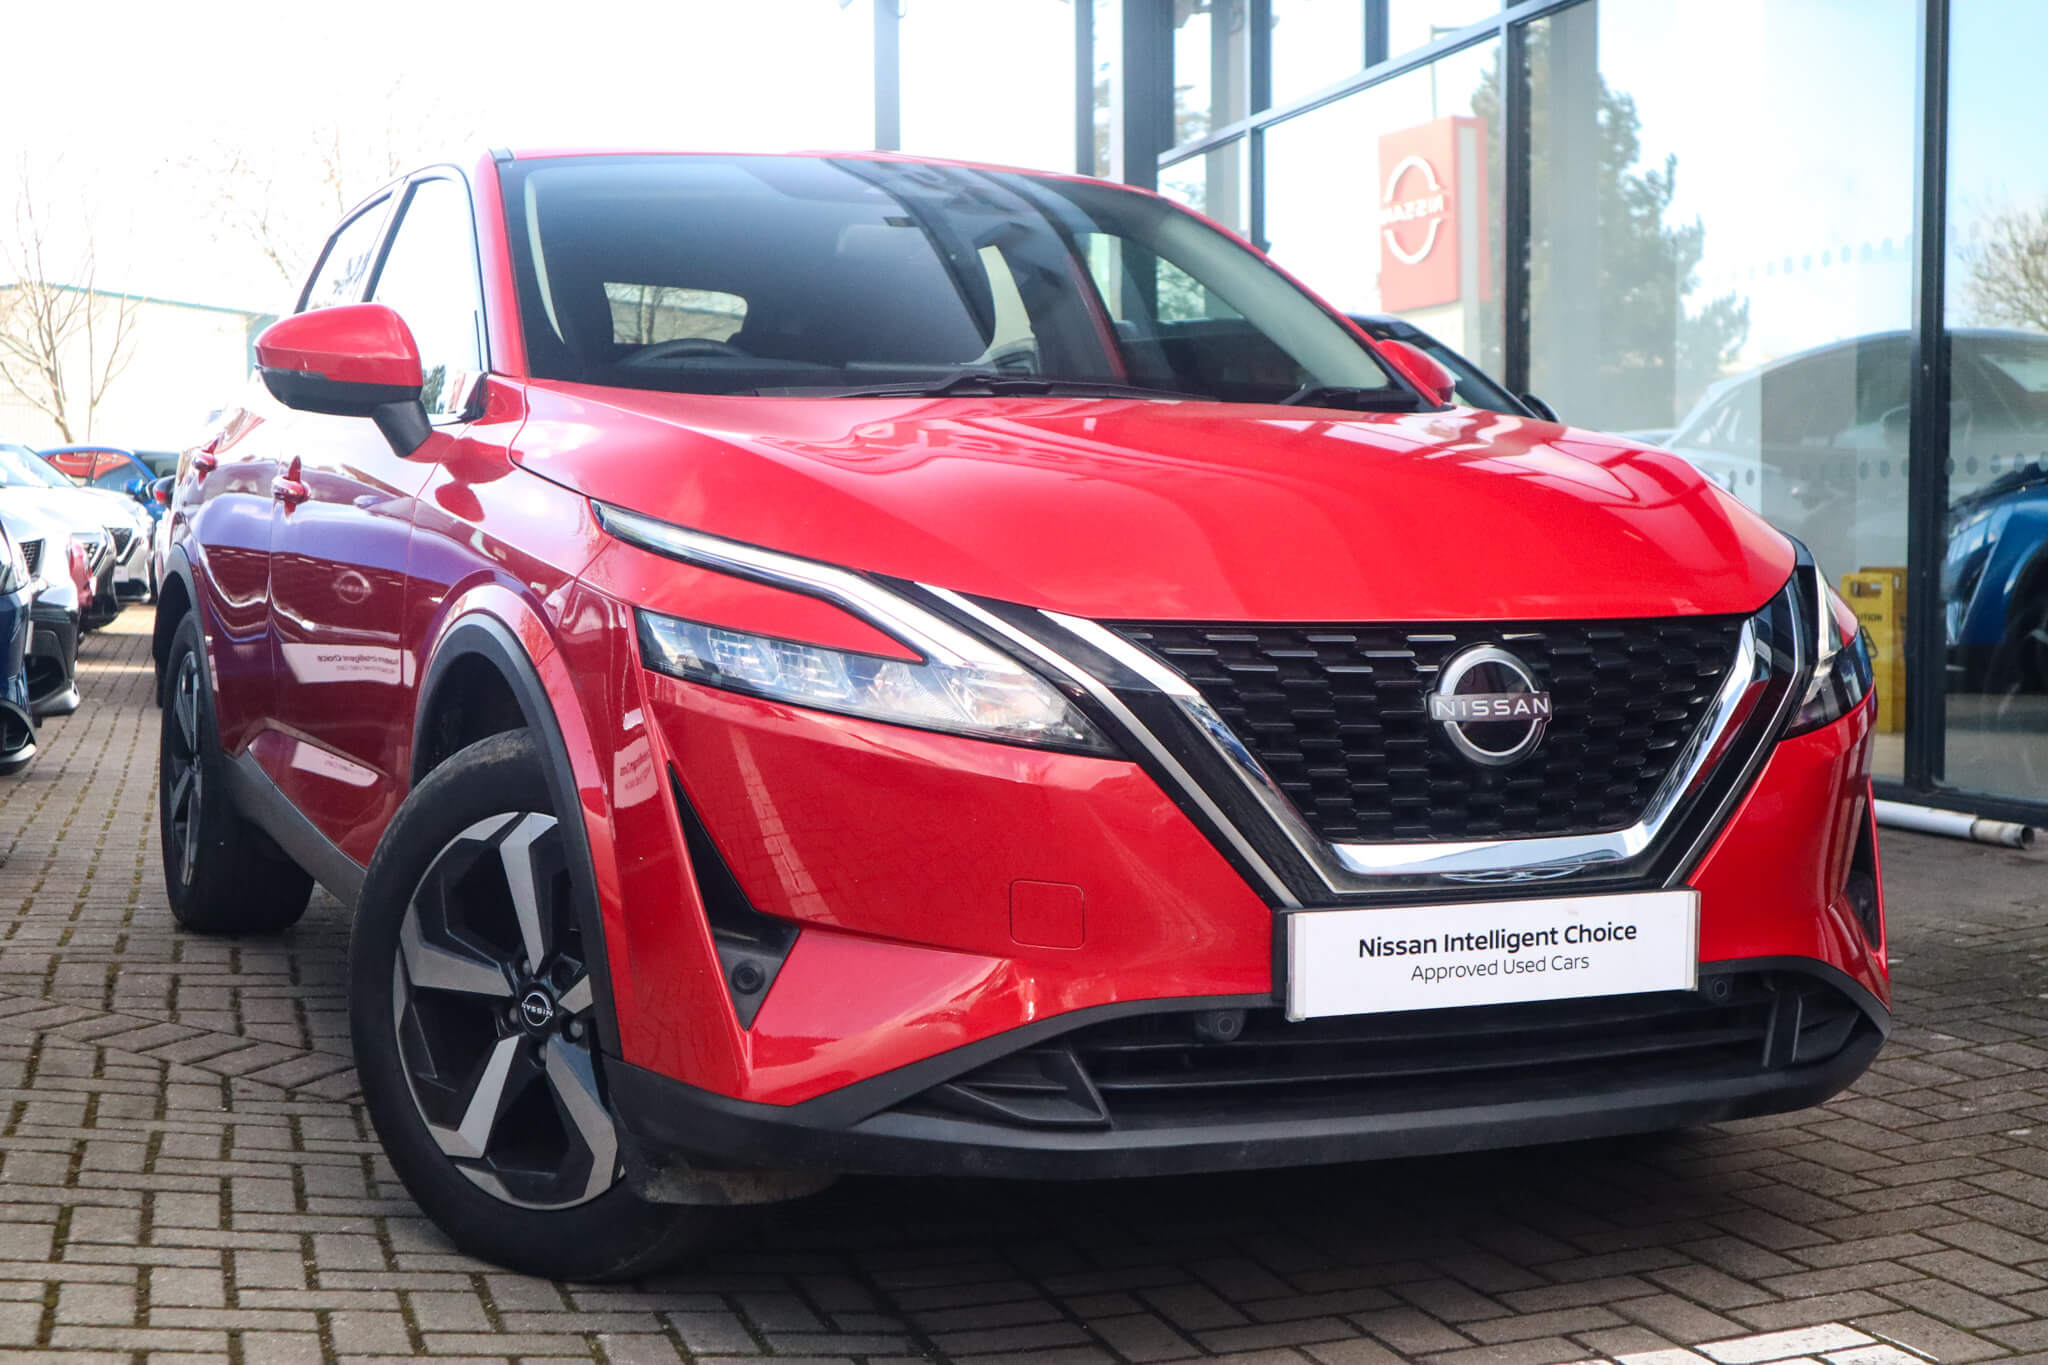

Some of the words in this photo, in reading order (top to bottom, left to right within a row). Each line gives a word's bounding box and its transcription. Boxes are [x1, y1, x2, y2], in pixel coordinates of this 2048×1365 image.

[1436, 698, 1549, 717] NISSAN
[1359, 936, 1437, 958] Nissan
[1444, 926, 1558, 953] Intelligent
[1564, 921, 1637, 944] Choice
[1411, 959, 1498, 983] Approved
[1503, 956, 1546, 974] Used
[1551, 954, 1590, 971] Cars
[521, 1002, 553, 1017] NISSAN
